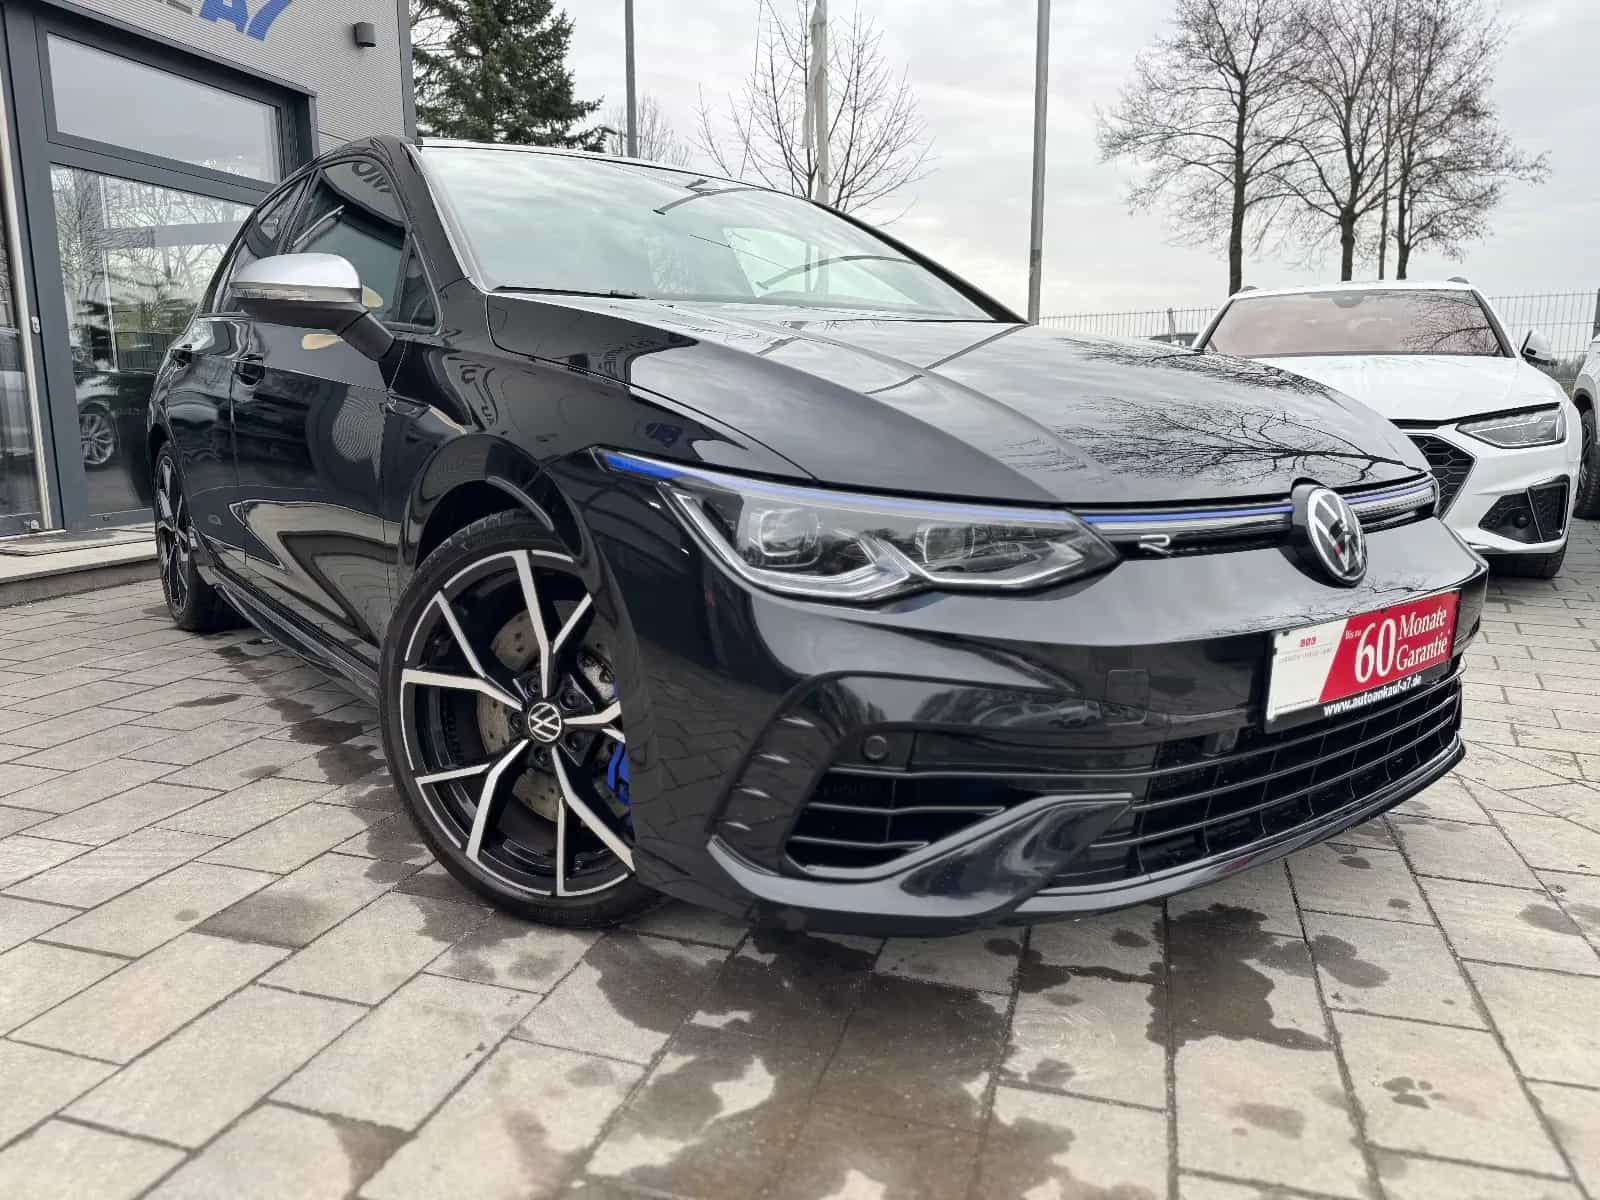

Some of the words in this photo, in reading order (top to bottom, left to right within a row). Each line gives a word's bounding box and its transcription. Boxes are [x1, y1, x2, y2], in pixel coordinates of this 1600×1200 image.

[1398, 606, 1447, 640] Monate
[1355, 618, 1396, 683] 60
[1323, 673, 1422, 716] www.autoankauf-a7.de
